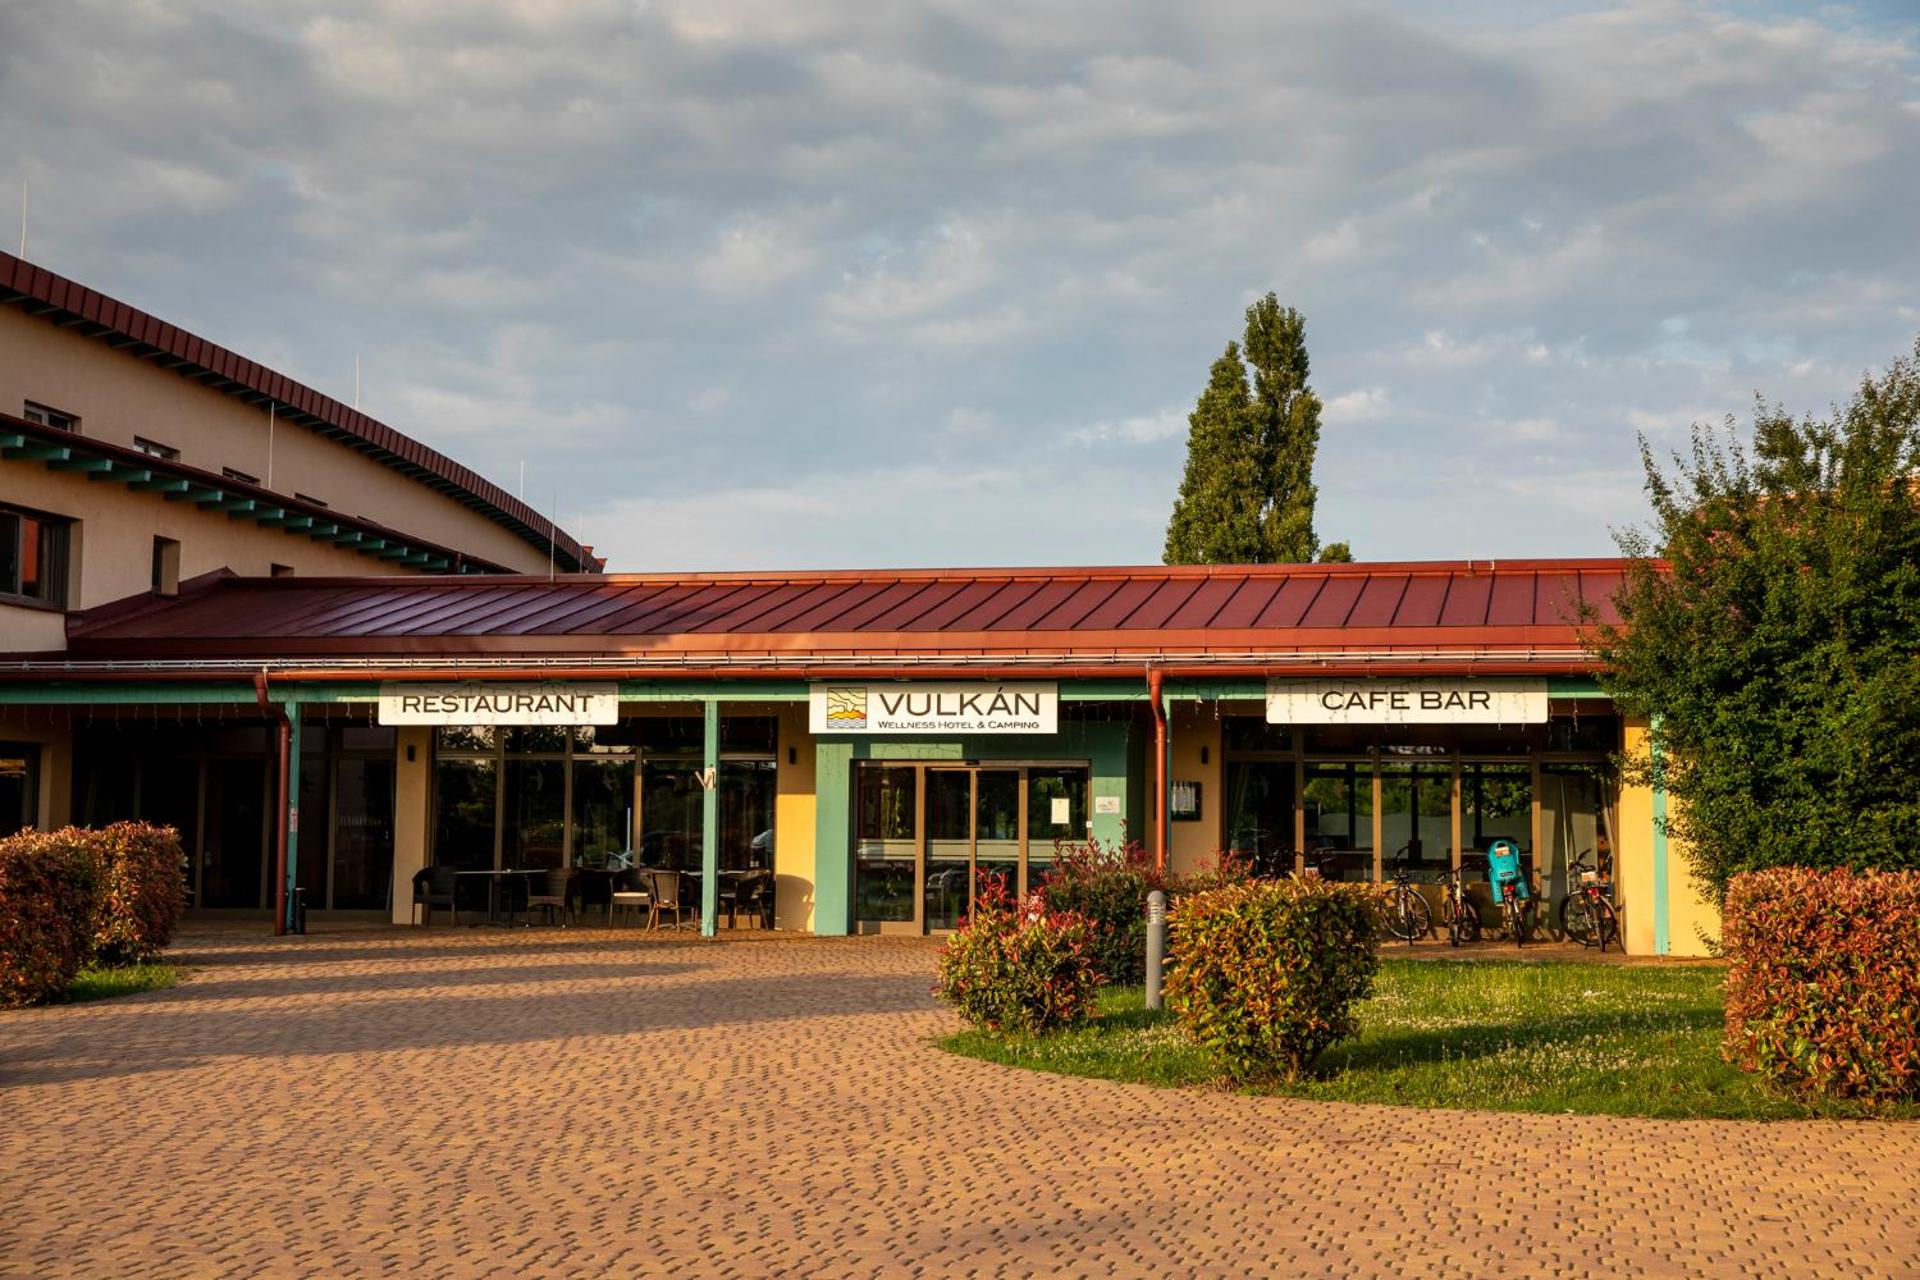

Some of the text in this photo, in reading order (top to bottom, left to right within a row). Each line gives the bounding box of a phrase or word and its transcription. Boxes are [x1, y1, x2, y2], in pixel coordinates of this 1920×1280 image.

[402, 694, 595, 713] RESTAURANT
[878, 686, 1040, 716] VULKÁN
[1322, 691, 1491, 710] CAFE BAR
[977, 721, 985, 729] &
